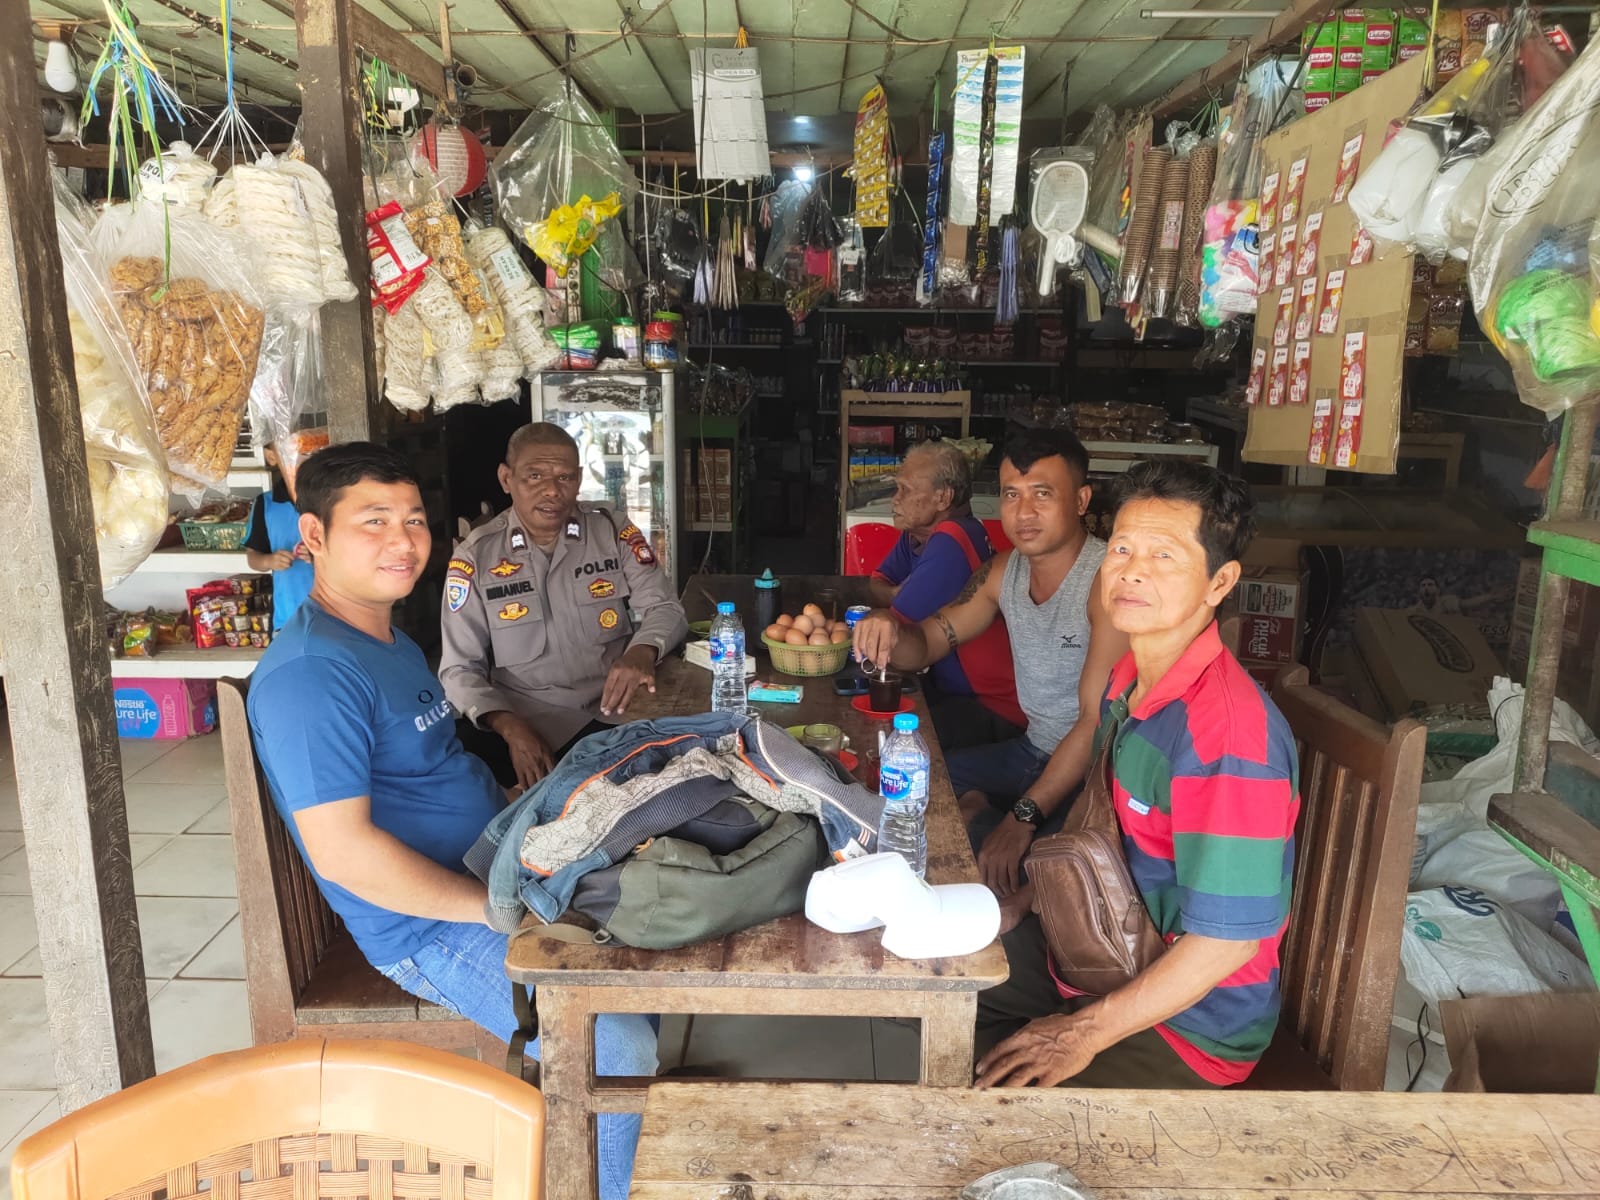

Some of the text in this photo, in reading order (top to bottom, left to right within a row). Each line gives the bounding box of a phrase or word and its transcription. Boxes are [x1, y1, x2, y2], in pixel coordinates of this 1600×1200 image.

[575, 558, 619, 578] POLRI
[116, 709, 156, 723] ure Life
